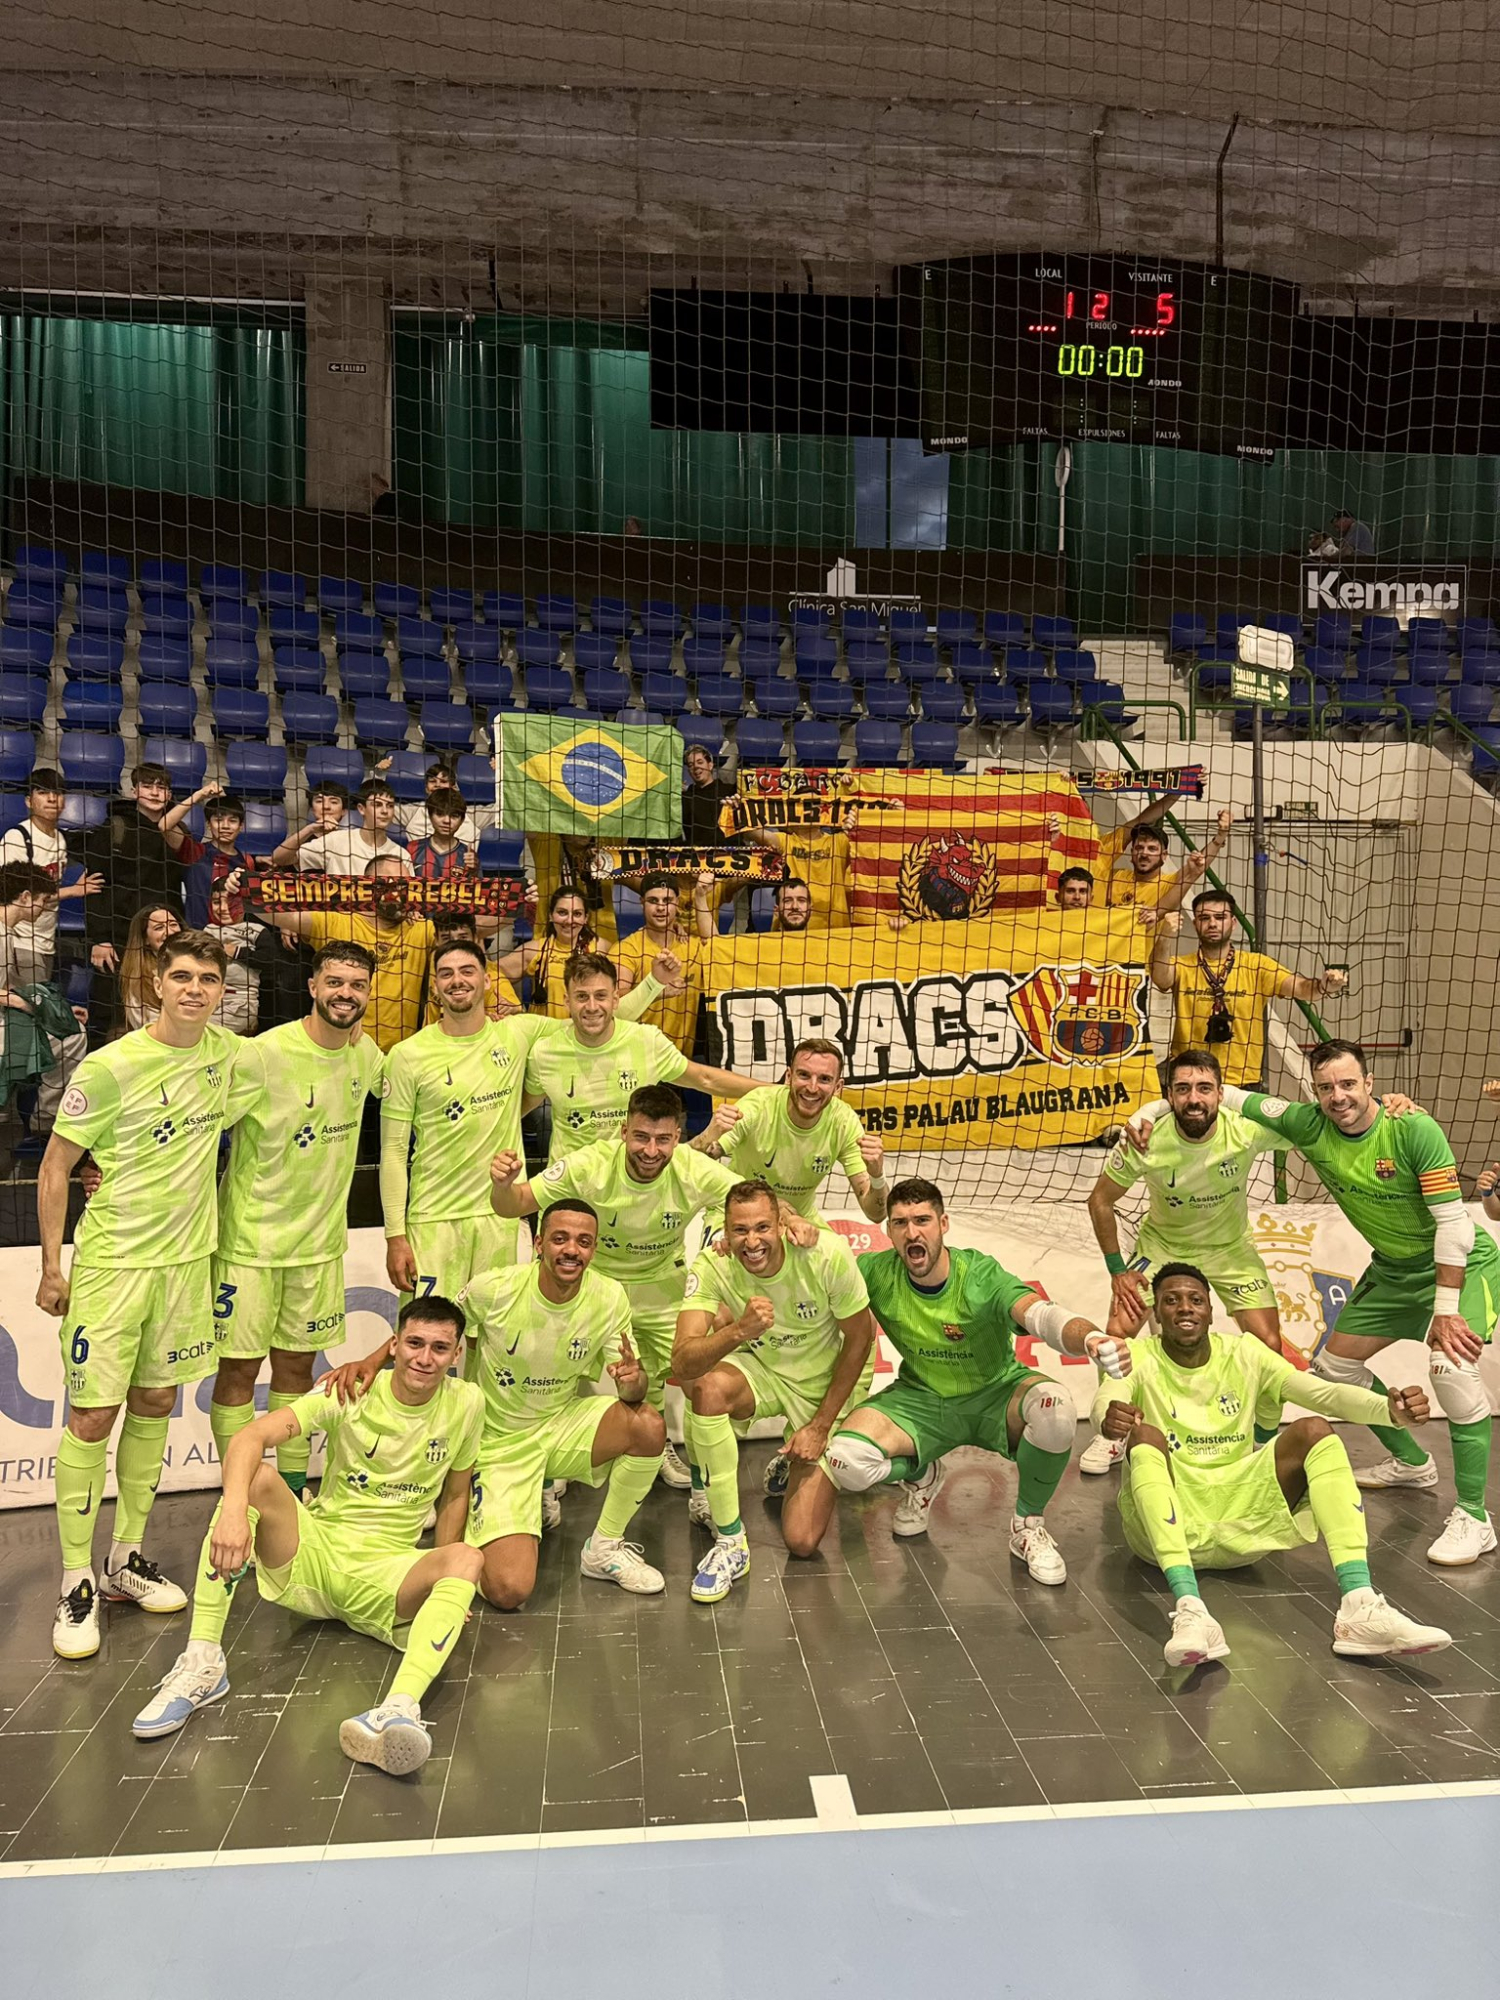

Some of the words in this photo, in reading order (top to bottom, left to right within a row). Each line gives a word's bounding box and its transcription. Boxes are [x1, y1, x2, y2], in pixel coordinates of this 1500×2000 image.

[1035, 268, 1063, 279] LOCAL
[1128, 272, 1173, 283] VISITANTE
[1157, 292, 1175, 325] 5
[1058, 344, 1144, 378] 00:00
[930, 436, 968, 446] MONDO
[1022, 426, 1048, 436] FALTAS
[1078, 428, 1126, 439] EXPULSIONES
[1155, 431, 1181, 440] FALTAS
[1237, 445, 1274, 456] MONDO
[1307, 570, 1460, 617] Kempa
[1235, 667, 1257, 684] SALIDA
[1261, 673, 1270, 687] DE
[1124, 769, 1182, 790] 1991
[621, 848, 750, 872] DRACS
[261, 880, 373, 903] SEMPRE
[408, 880, 486, 905] REBEL
[718, 970, 1028, 1088] DRACS
[904, 1097, 979, 1129] PALAU
[986, 1081, 1131, 1121] BLAUGRANA
[213, 1282, 237, 1319] 3
[306, 1312, 341, 1333] 3cat
[70, 1325, 89, 1364] 6
[167, 1341, 206, 1364] 3cat
[1185, 1432, 1246, 1444] Assistència
